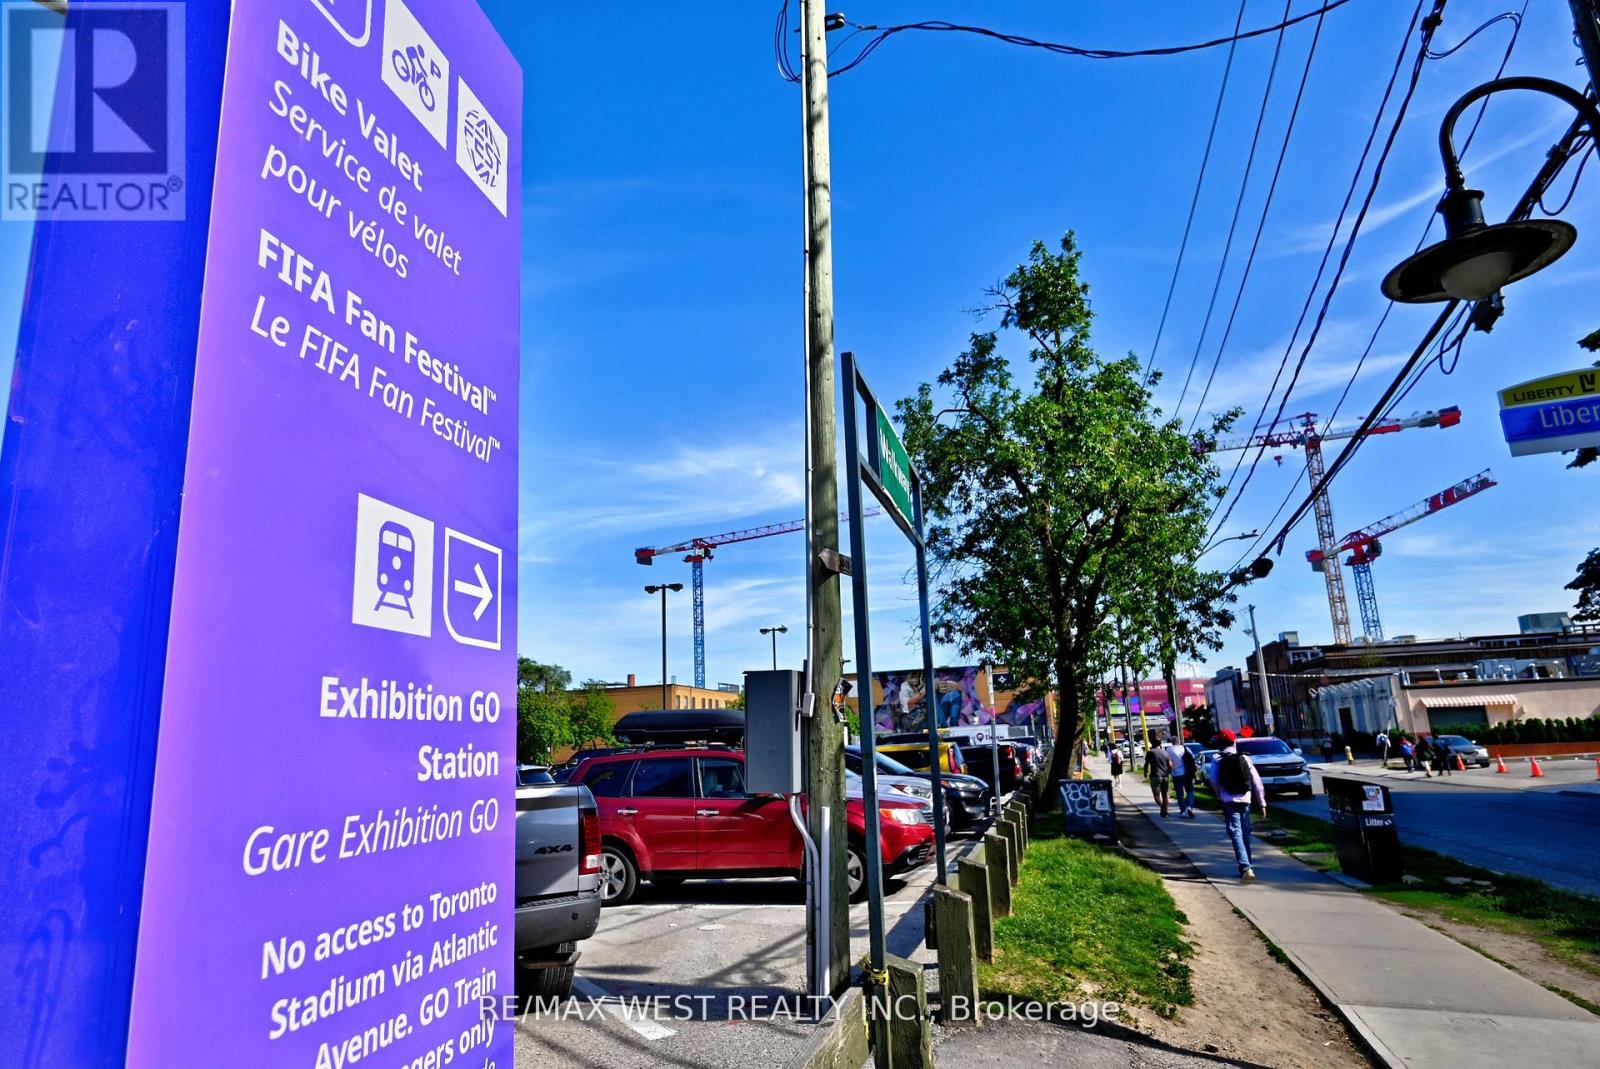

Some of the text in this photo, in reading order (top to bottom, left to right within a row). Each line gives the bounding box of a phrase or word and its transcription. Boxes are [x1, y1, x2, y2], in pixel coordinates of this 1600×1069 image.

[277, 19, 423, 193] Bike Valet
[261, 144, 409, 279] pour vélos
[268, 80, 463, 276] Service de valet
[257, 228, 336, 315] FIFA
[345, 289, 396, 354] Fan
[250, 295, 290, 348] Le
[299, 324, 360, 391] FIFA
[368, 366, 414, 419] Fan
[1513, 385, 1575, 402] LIBERTY
[319, 676, 500, 723] Exhibition GO
[417, 743, 499, 782] Station
[242, 797, 499, 877] Gare Exhibition GO
[260, 881, 498, 980] No access to Toronto
[269, 922, 498, 1041] Stadium via Atlantic
[312, 967, 498, 1069] Avenue. GO Train
[459, 1016, 497, 1049] only
